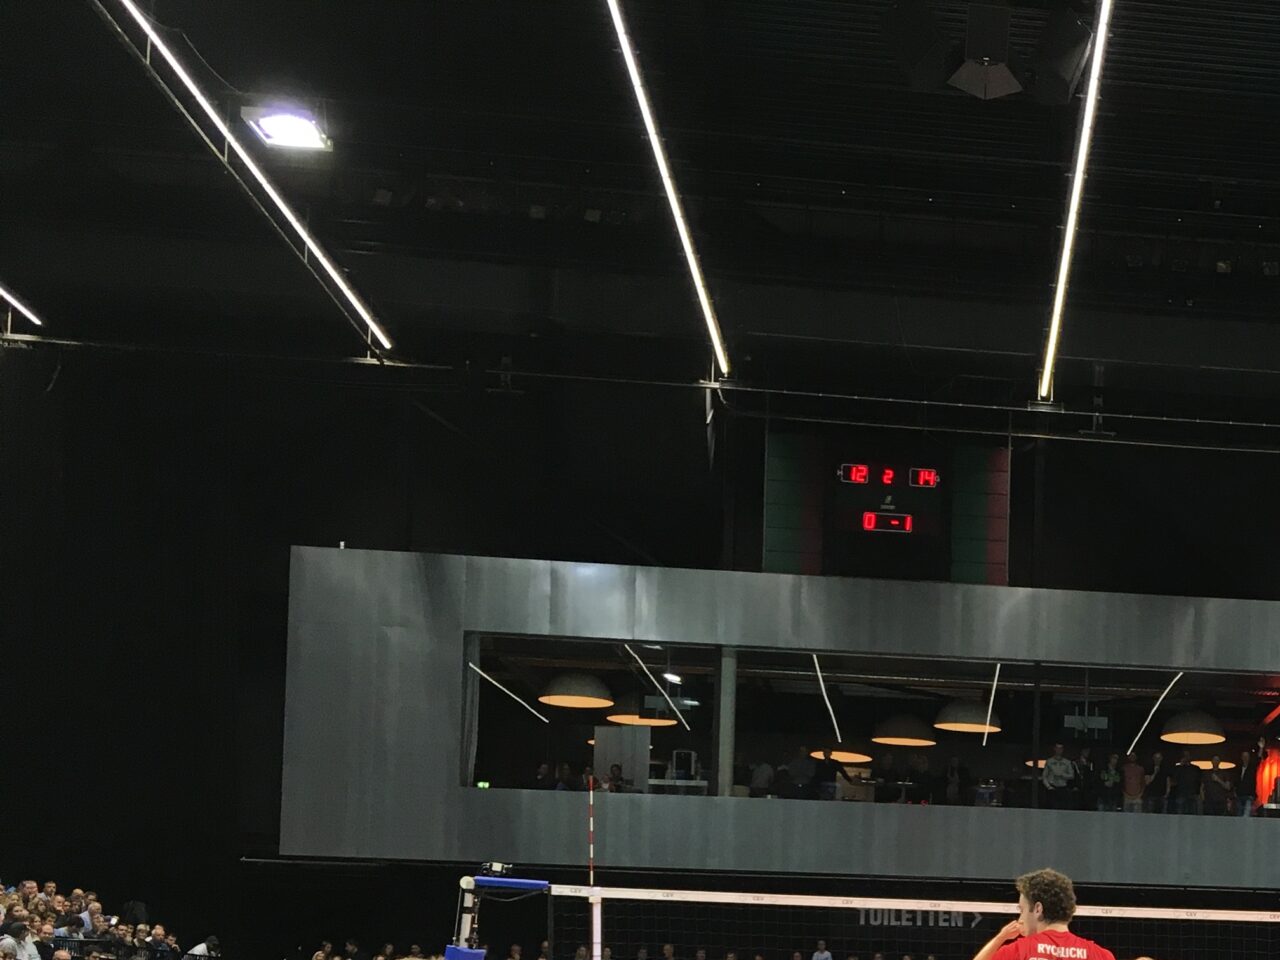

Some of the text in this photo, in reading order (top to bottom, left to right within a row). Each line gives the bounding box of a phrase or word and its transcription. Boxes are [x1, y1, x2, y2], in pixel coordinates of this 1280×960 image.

[850, 465, 868, 483] 12
[882, 469, 894, 484] 2
[918, 469, 936, 486] 14
[862, 512, 876, 531] 0
